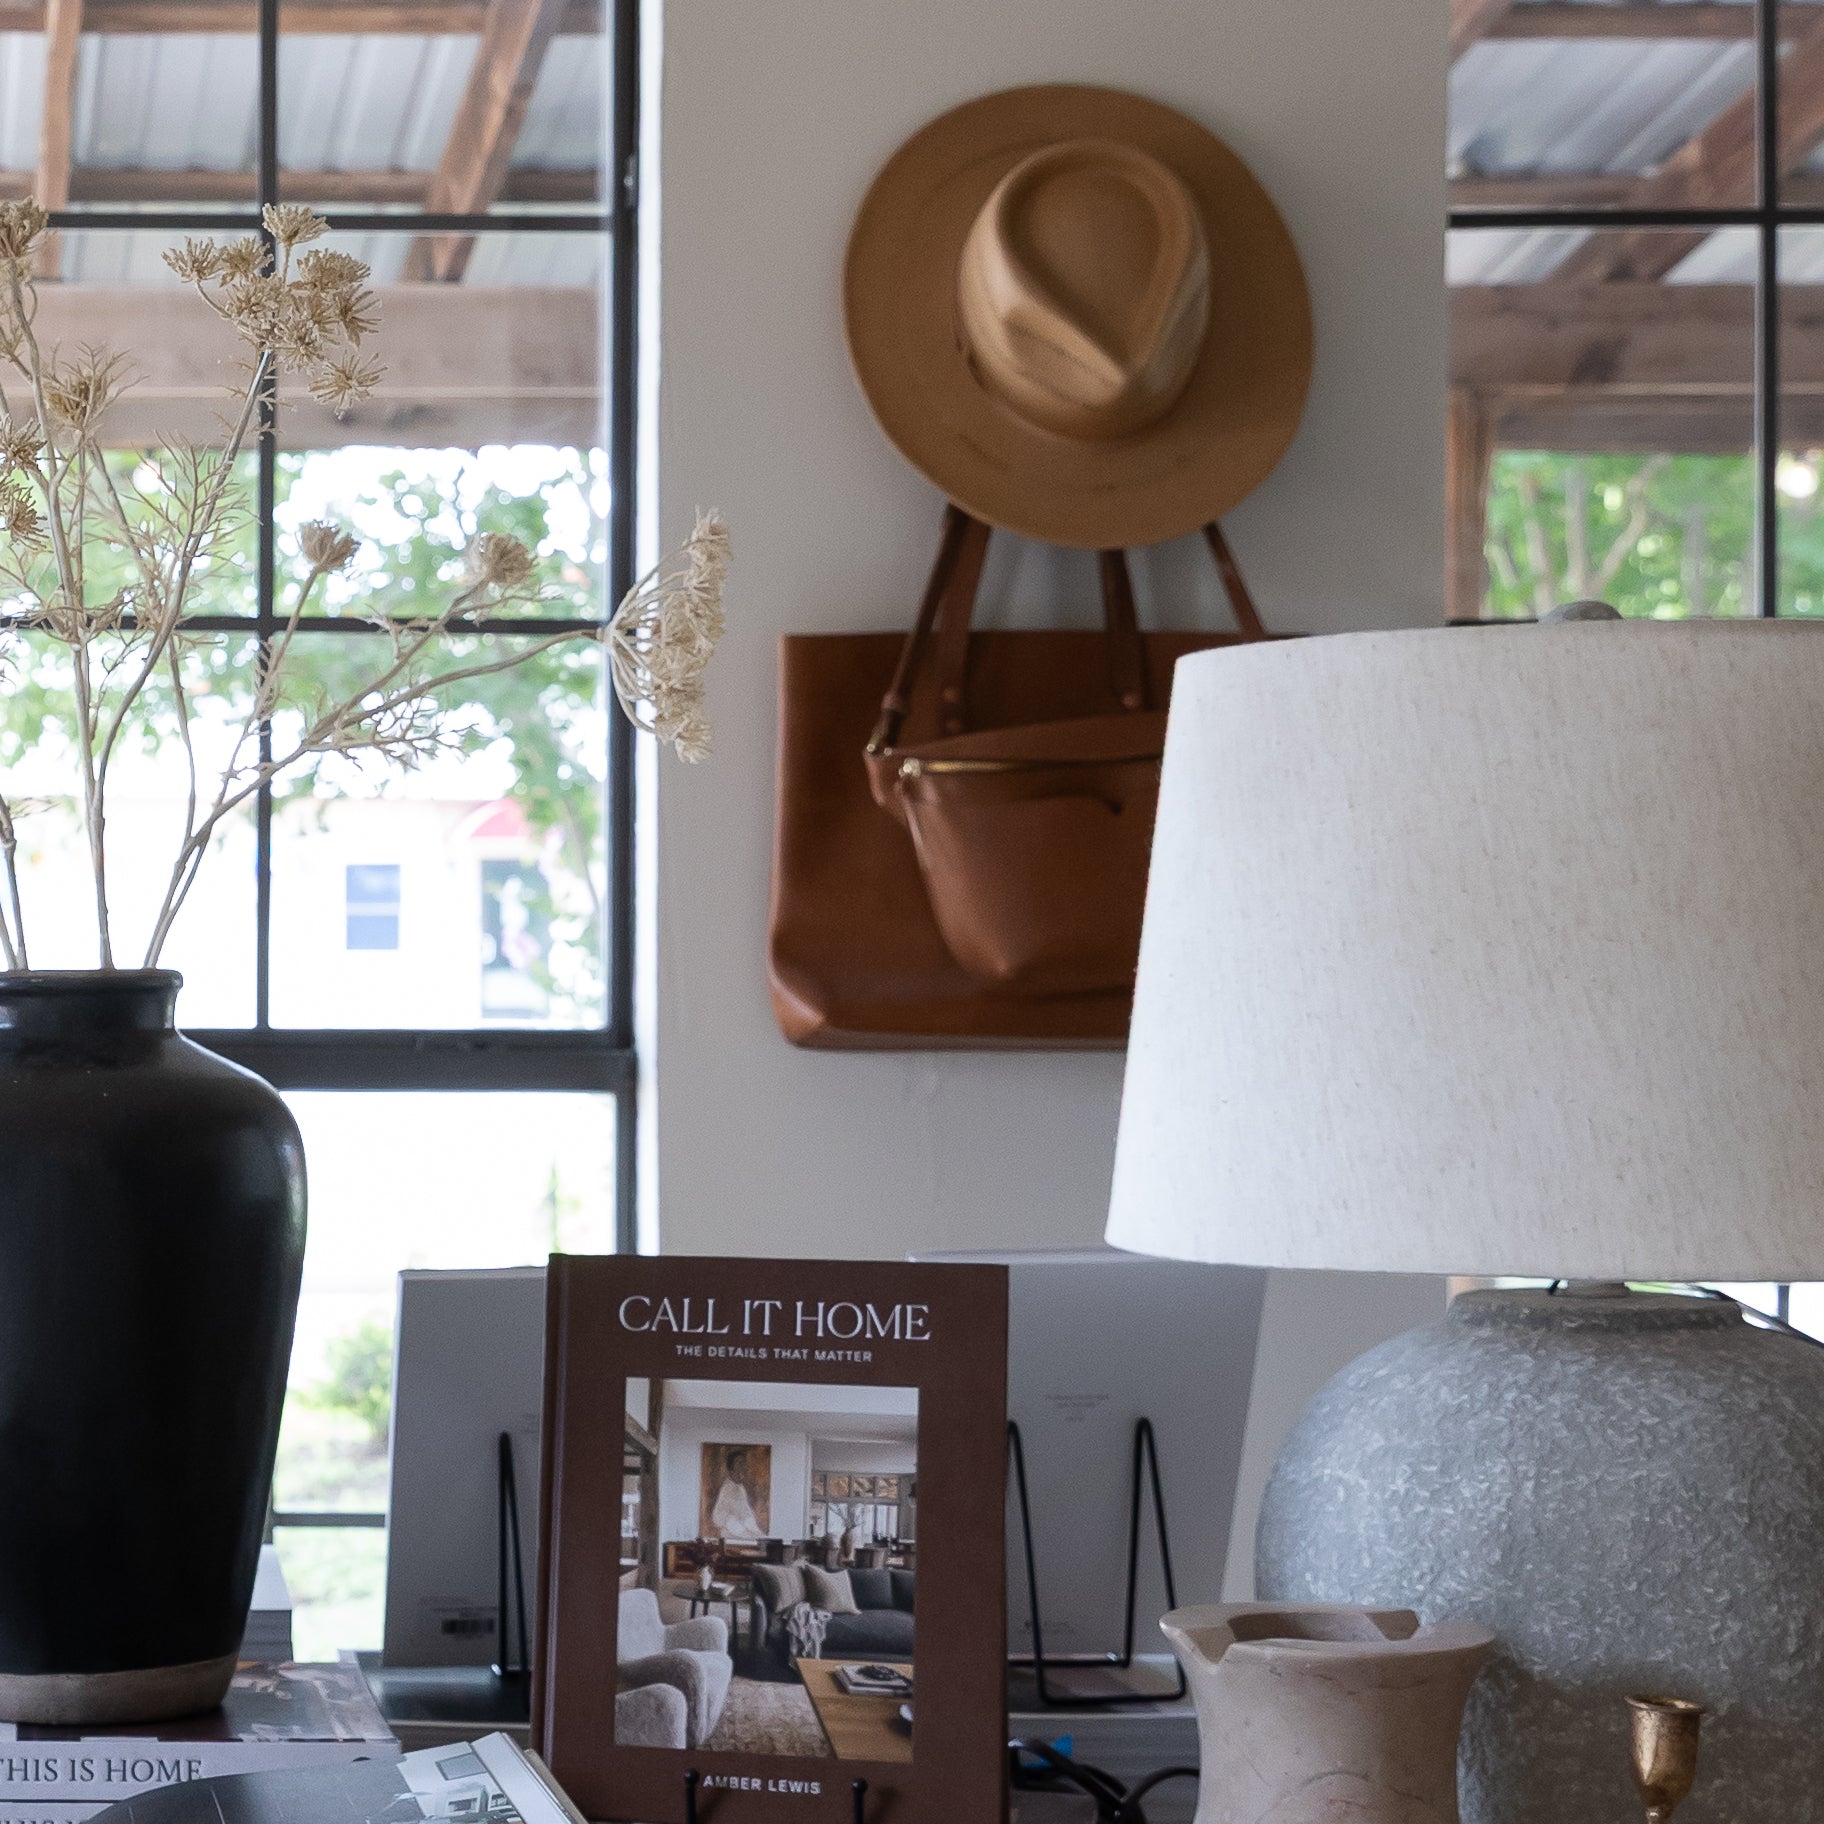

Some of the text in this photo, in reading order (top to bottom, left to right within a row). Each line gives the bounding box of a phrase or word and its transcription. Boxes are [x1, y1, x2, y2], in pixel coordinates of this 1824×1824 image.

[618, 1295, 932, 1341] CALL IT HOME
[675, 1344, 873, 1363] THE DETAILS THAT MATTER
[69, 1758, 94, 1782] IS
[105, 1758, 202, 1782] HOME
[702, 1775, 821, 1795] AMBER LEWIS
